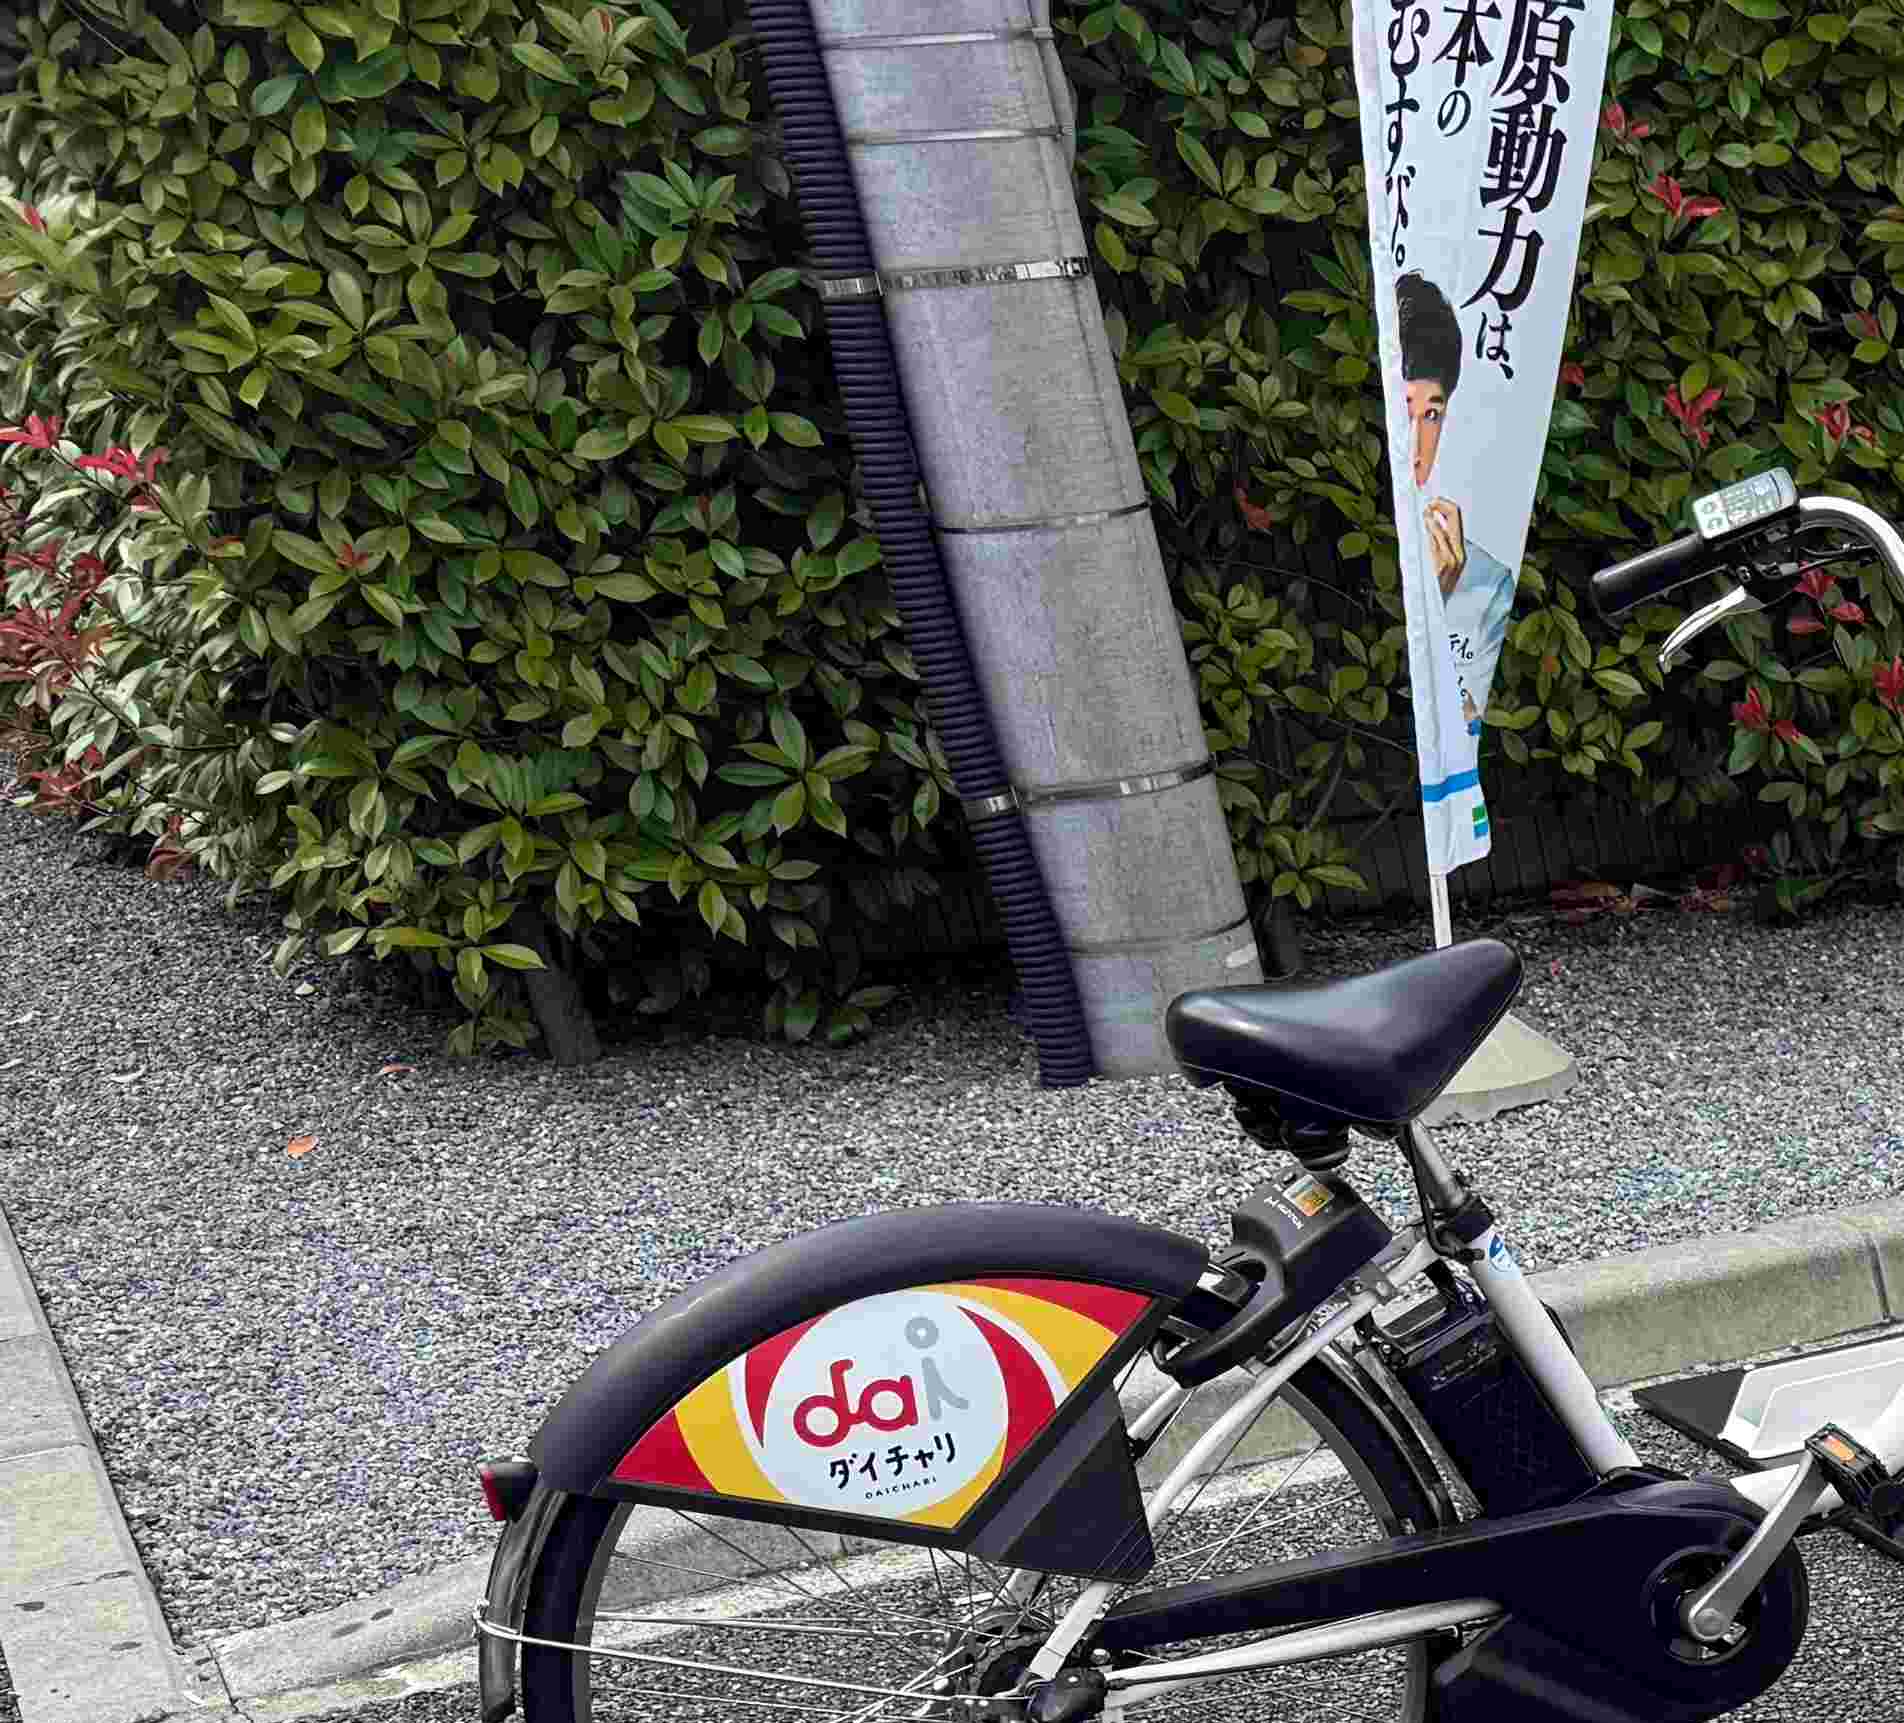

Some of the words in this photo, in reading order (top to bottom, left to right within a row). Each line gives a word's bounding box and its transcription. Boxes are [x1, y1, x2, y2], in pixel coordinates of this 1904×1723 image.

[793, 1316, 969, 1448] dai
[828, 1432, 957, 1490] ダイチャリ
[865, 1476, 938, 1500] DAICHARI
